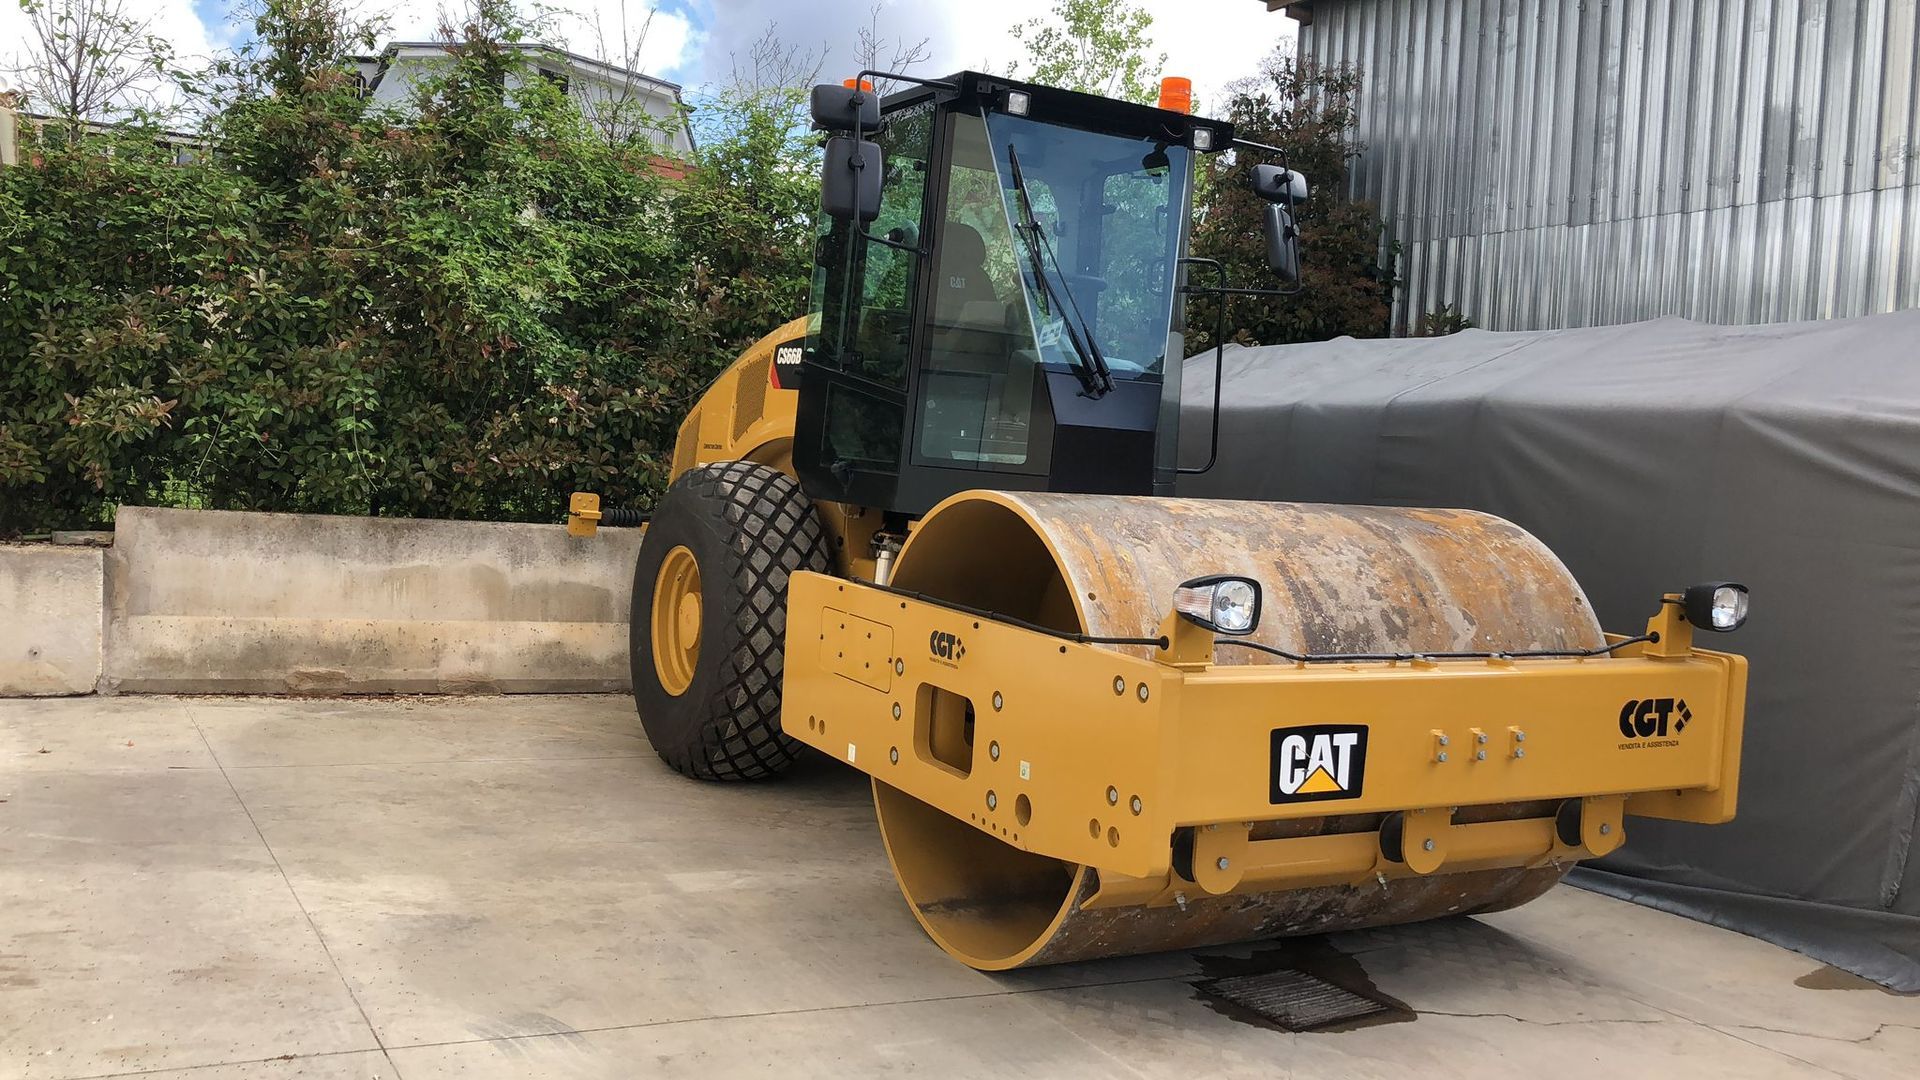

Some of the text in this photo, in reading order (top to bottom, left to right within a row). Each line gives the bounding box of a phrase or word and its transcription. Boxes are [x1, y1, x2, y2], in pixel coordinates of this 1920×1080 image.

[950, 276, 966, 289] CAT
[777, 347, 803, 365] CS66B
[930, 630, 956, 660] CGT
[1619, 698, 1674, 738] CGT
[1647, 740, 1679, 748] ASSISTENZA
[1279, 732, 1358, 795] CAT
